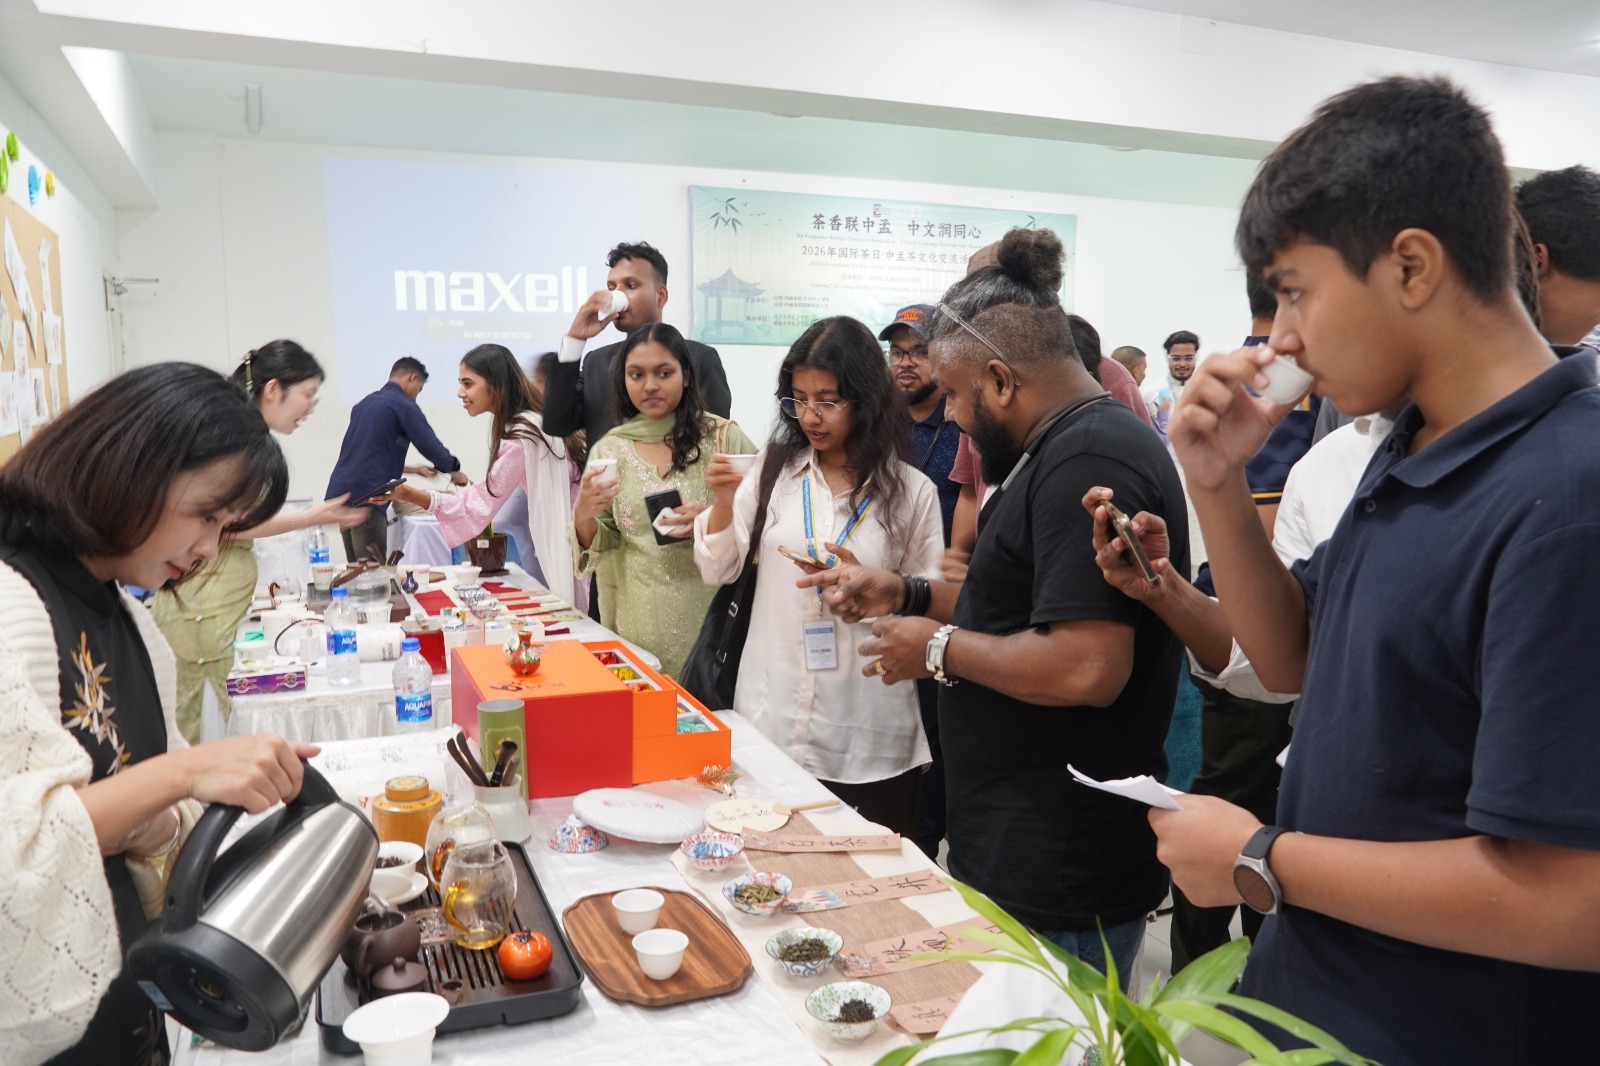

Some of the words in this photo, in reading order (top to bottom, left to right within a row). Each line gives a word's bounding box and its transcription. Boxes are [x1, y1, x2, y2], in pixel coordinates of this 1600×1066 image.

[812, 213, 893, 235] 茶香联中孟
[908, 219, 982, 240] 中文润同心
[394, 265, 587, 313] maxell
[500, 331, 532, 340] DETECTED
